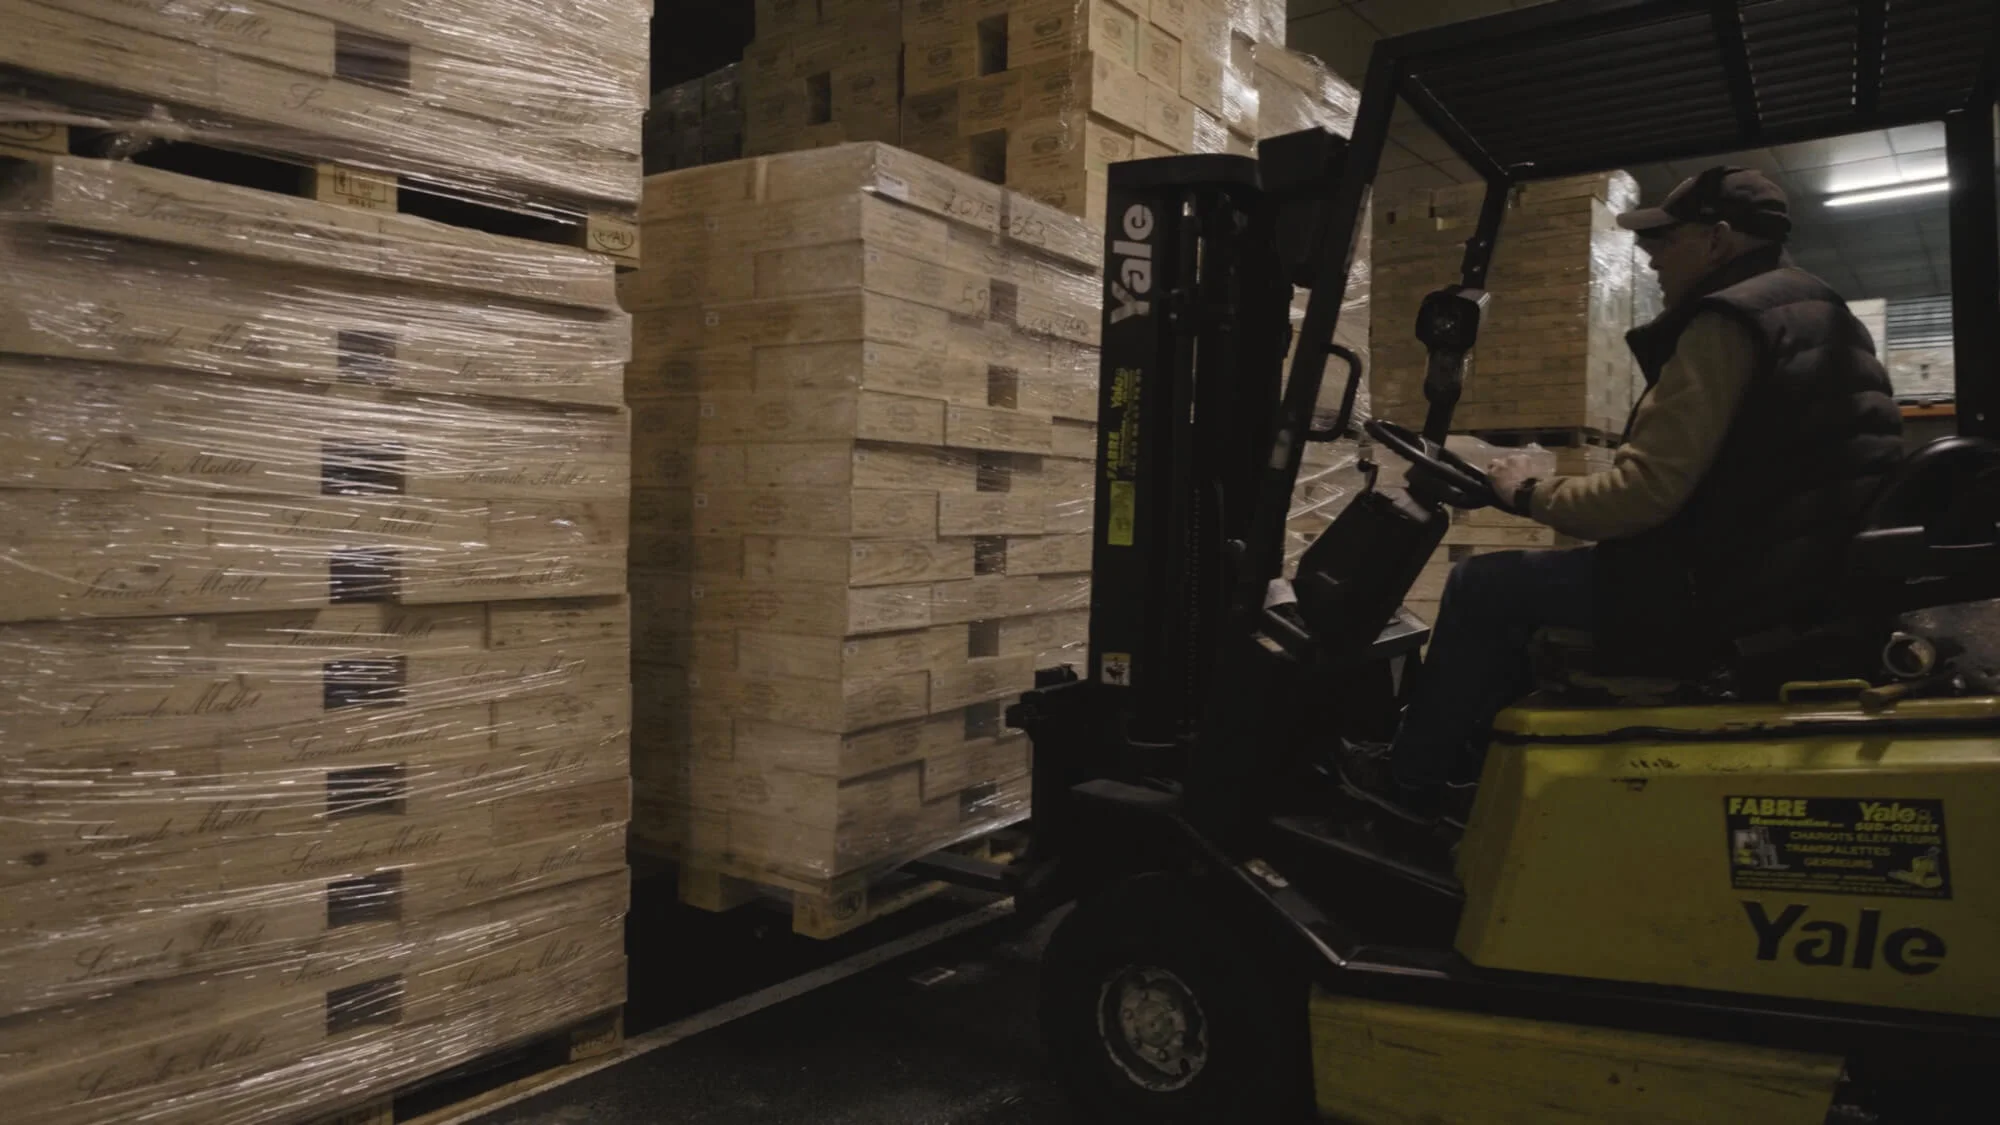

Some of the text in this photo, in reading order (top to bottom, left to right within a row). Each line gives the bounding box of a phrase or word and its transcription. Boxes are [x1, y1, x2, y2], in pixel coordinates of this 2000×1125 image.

[1110, 204, 1153, 324] Yale
[1728, 798, 1917, 823] FABRE Yale
[1790, 831, 1853, 842] CHARIOTS
[1855, 822, 1939, 833] SUD-OUEST
[1784, 843, 1891, 857] TRANSPALETTES
[1741, 899, 1948, 976] Yale
